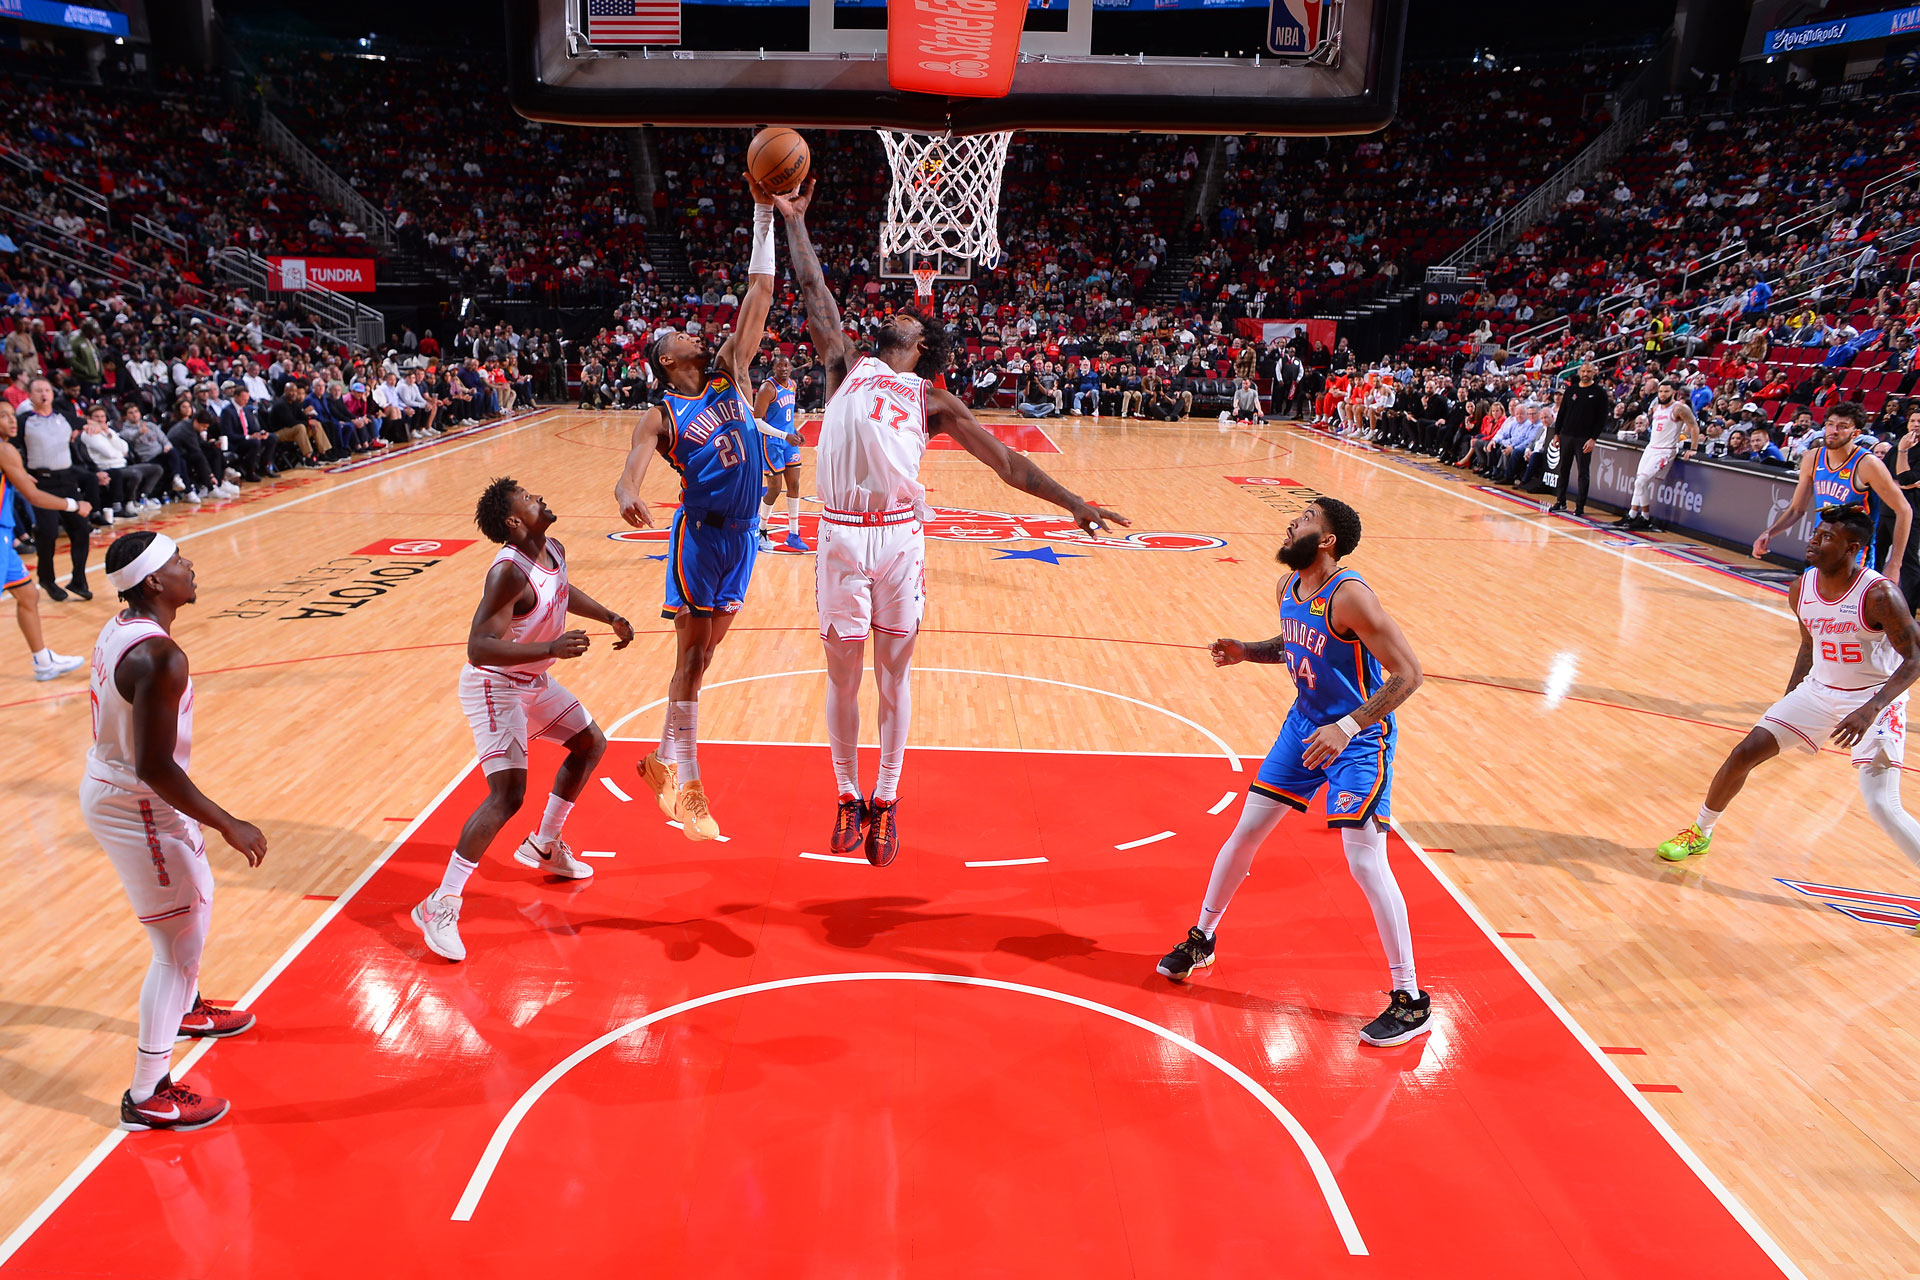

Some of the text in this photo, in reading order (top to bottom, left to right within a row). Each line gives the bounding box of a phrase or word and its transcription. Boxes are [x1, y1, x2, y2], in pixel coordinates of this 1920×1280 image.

[1275, 26, 1299, 46] NBA
[769, 155, 804, 185] Wilson
[310, 268, 362, 282] TUNDRA
[843, 374, 917, 402] H-Town
[683, 398, 746, 446] THUNDER
[785, 408, 792, 422] 8
[868, 395, 910, 432] 17
[1656, 423, 1663, 432] 5
[713, 428, 747, 470] 21
[1543, 471, 1559, 488] AT&T
[1657, 480, 1703, 513] coffee
[207, 557, 372, 619] CENTER
[278, 559, 442, 620] TOYOTA
[1803, 616, 1859, 635] H-Town
[1821, 640, 1864, 664] 25
[138, 799, 170, 887] ROCKETS
